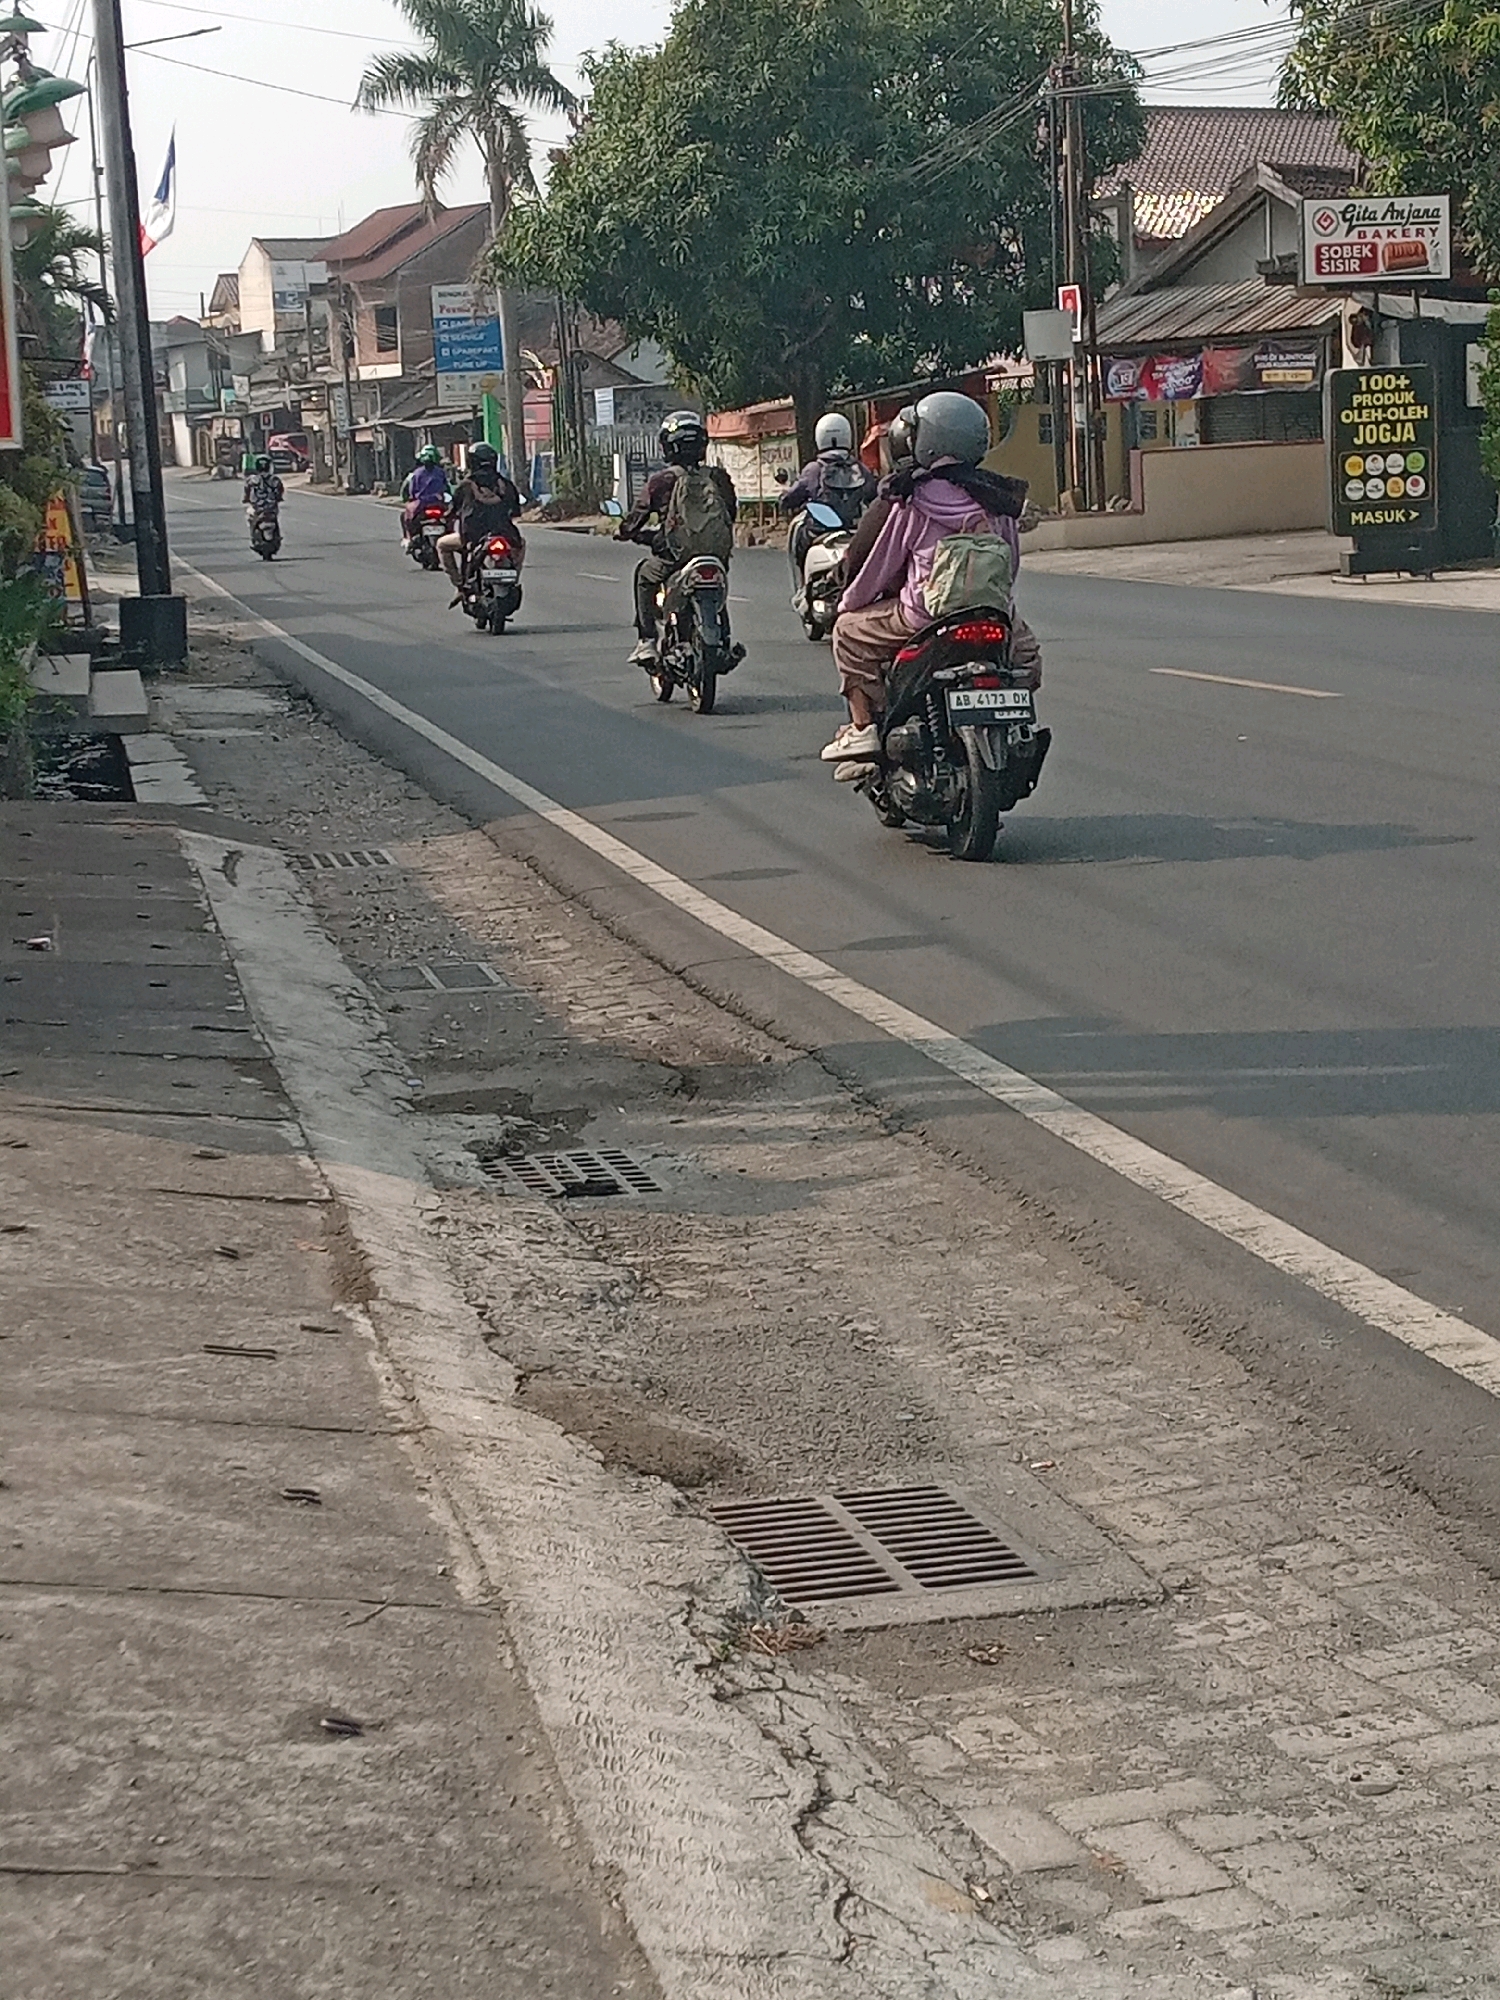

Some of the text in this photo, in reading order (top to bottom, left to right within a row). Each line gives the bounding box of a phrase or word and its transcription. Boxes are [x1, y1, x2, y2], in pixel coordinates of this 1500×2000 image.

[1338, 201, 1442, 233] Gita Anjana
[1357, 227, 1439, 239] BAKERY
[1320, 243, 1373, 259] SOBEK
[1320, 258, 1361, 273] SISIR
[1358, 374, 1411, 391] 100+
[1352, 390, 1415, 407] PRODUK
[1340, 405, 1429, 424] OLEH-OLEH
[1353, 422, 1416, 445] JOGJA
[1351, 509, 1406, 526] MASUK
[955, 694, 971, 706] AB
[976, 693, 1006, 705] 4173
